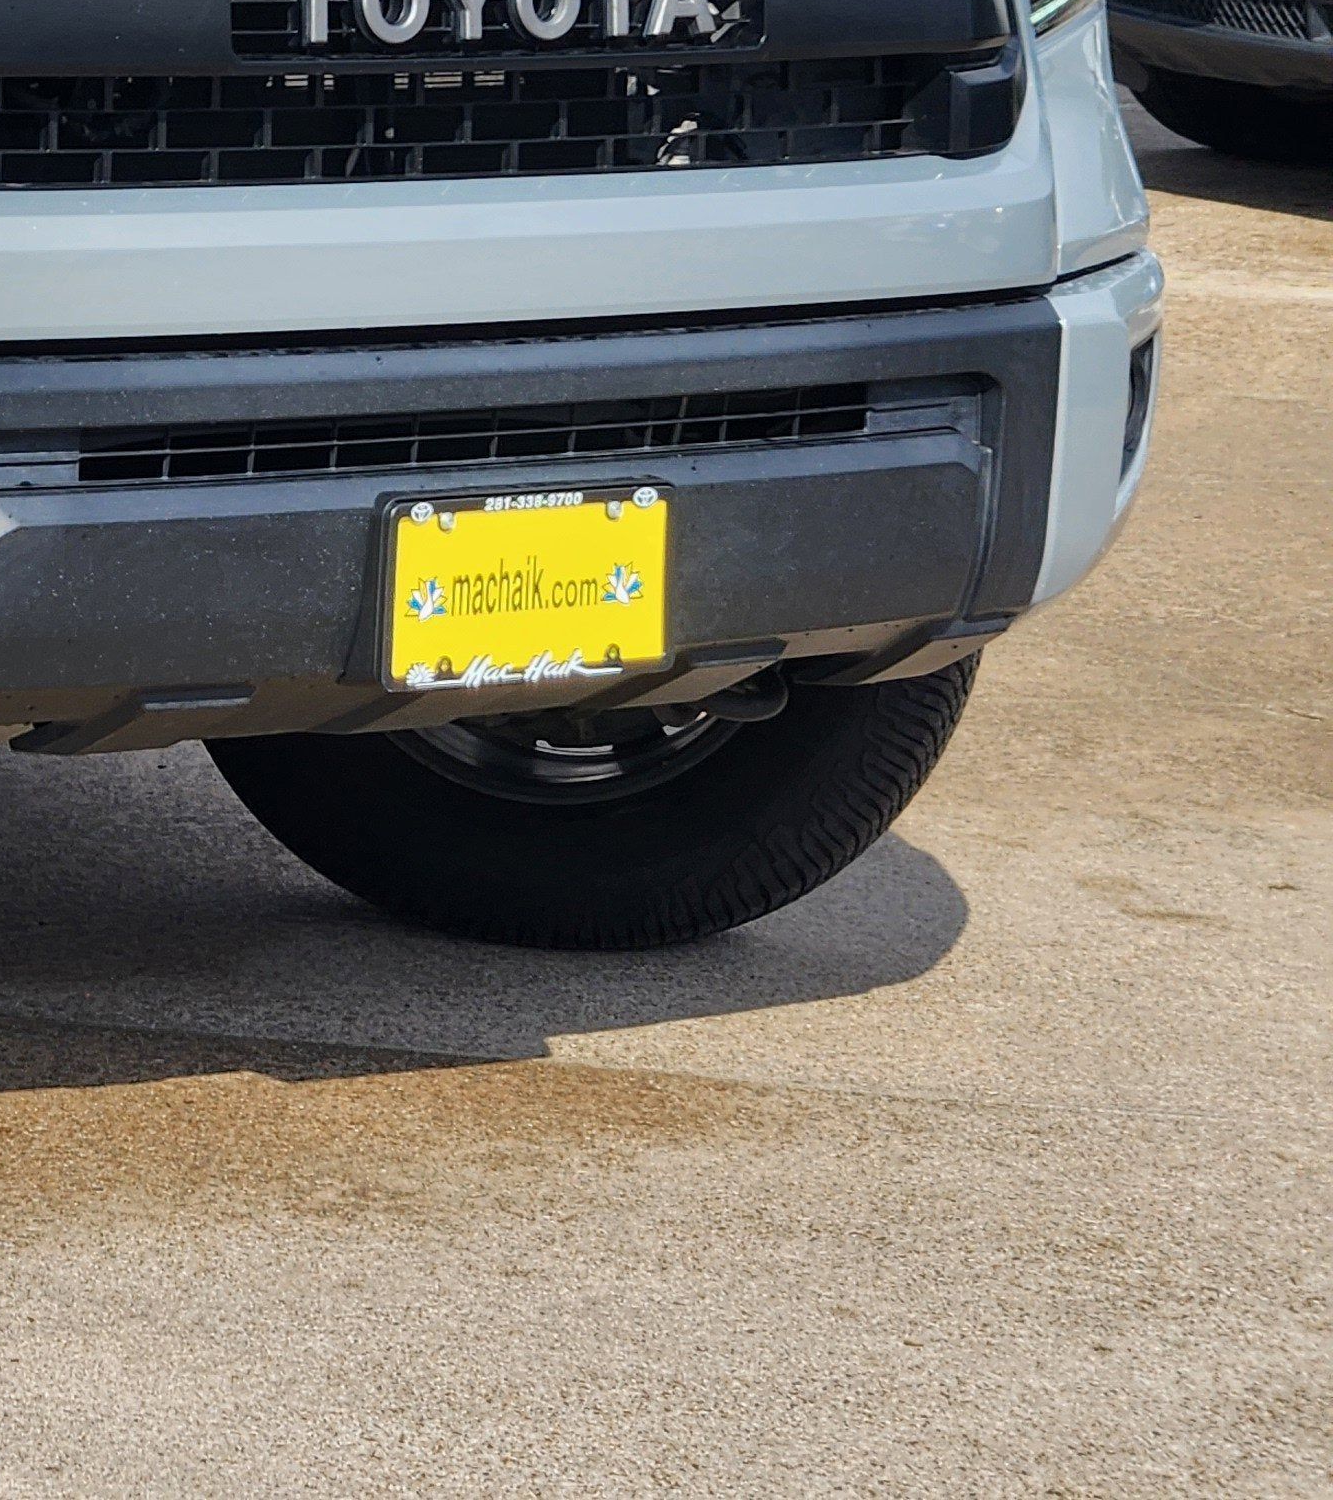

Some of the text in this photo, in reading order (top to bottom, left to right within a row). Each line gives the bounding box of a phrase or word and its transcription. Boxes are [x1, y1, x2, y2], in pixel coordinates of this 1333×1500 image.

[451, 555, 600, 618] machaik.com
[459, 647, 613, 690] Mac Haik
